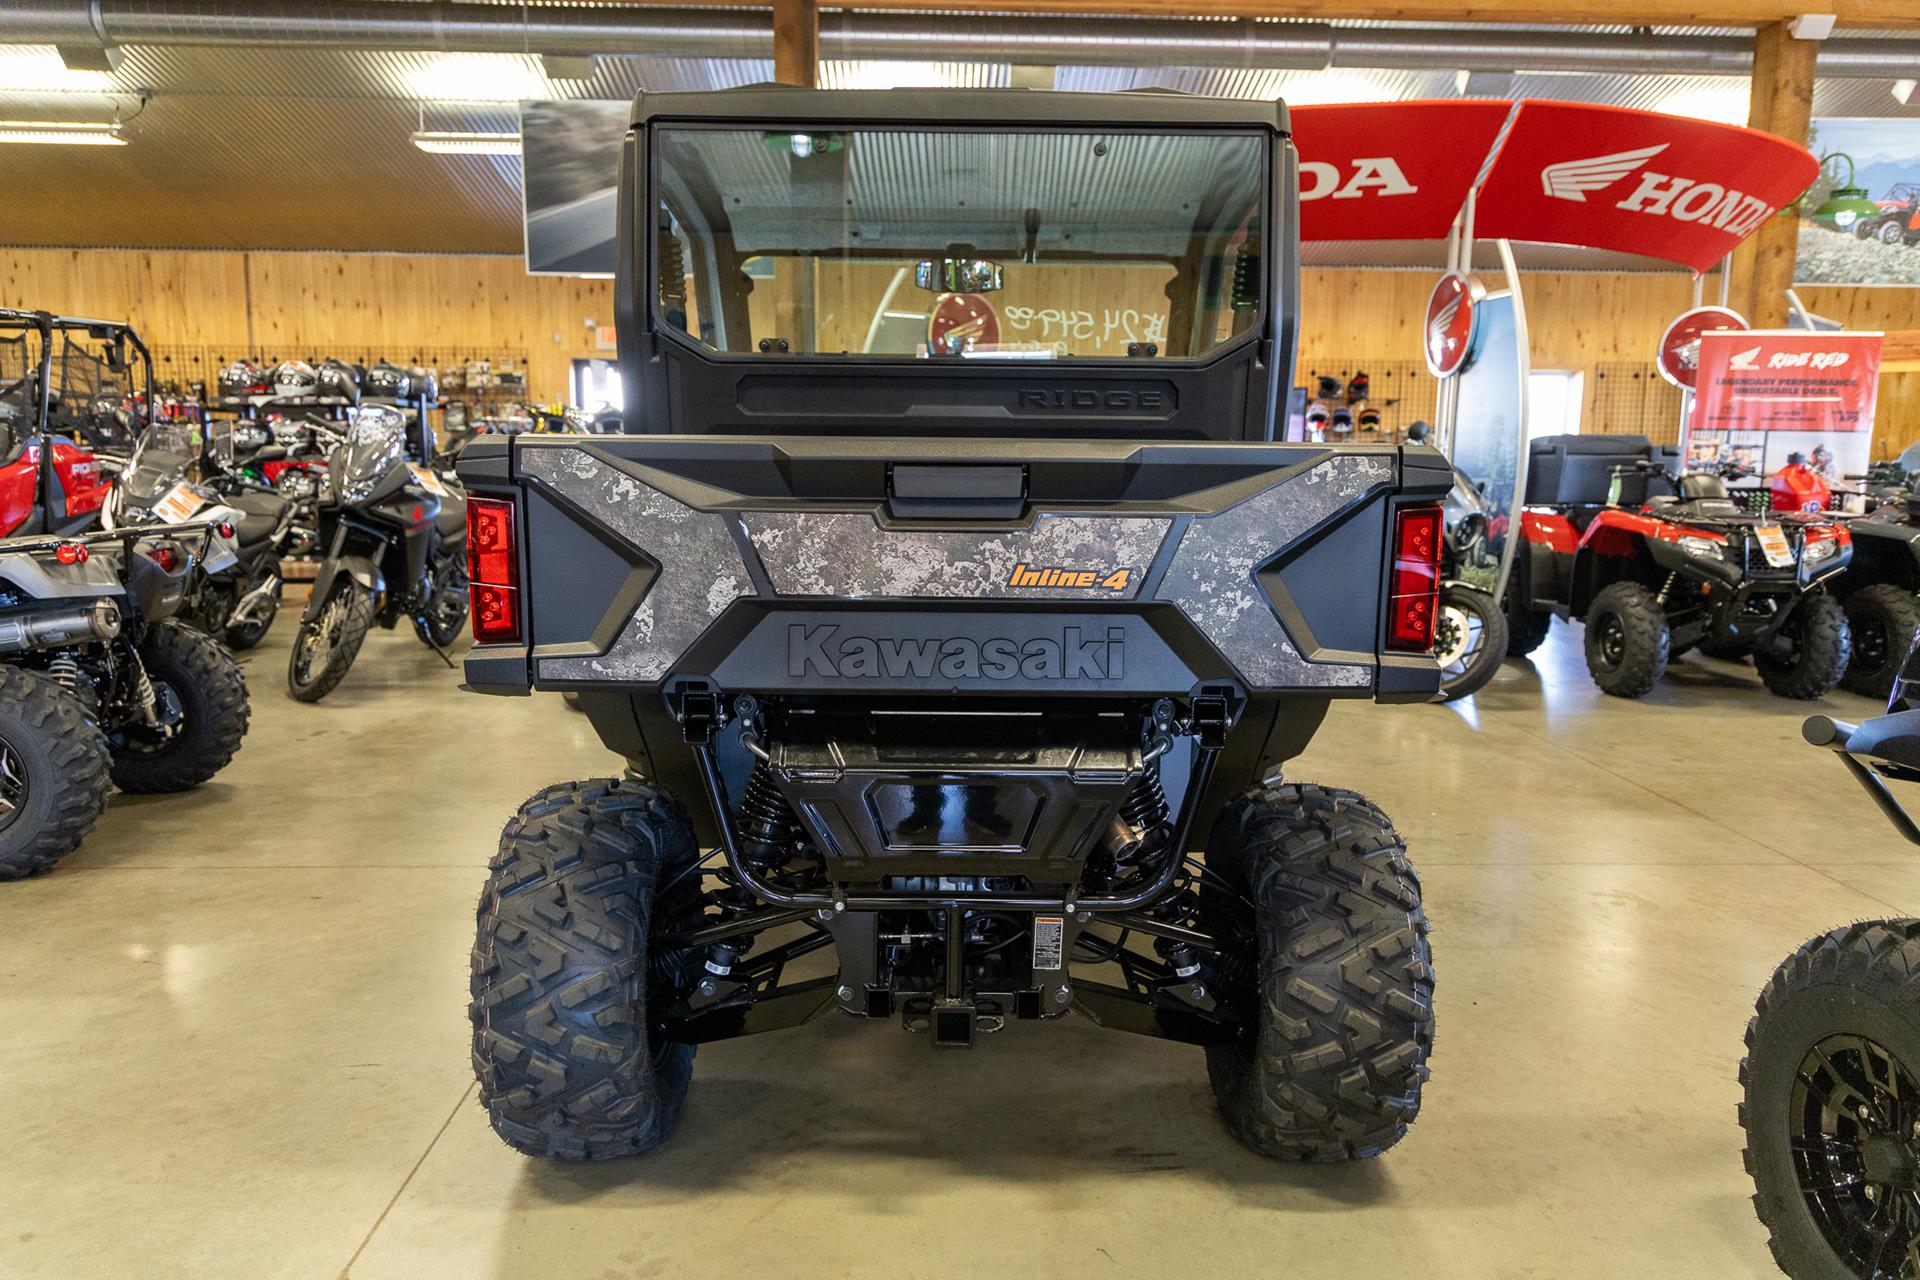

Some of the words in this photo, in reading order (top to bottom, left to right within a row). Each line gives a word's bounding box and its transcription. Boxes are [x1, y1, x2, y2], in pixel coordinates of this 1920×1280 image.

[1299, 157, 1418, 201] DA
[1767, 352, 1811, 369] RIDE
[1810, 352, 1850, 370] RED
[1019, 389, 1161, 408] RIDGE
[1008, 563, 1131, 591] Inline-4
[788, 624, 1125, 680] Kawasaki
